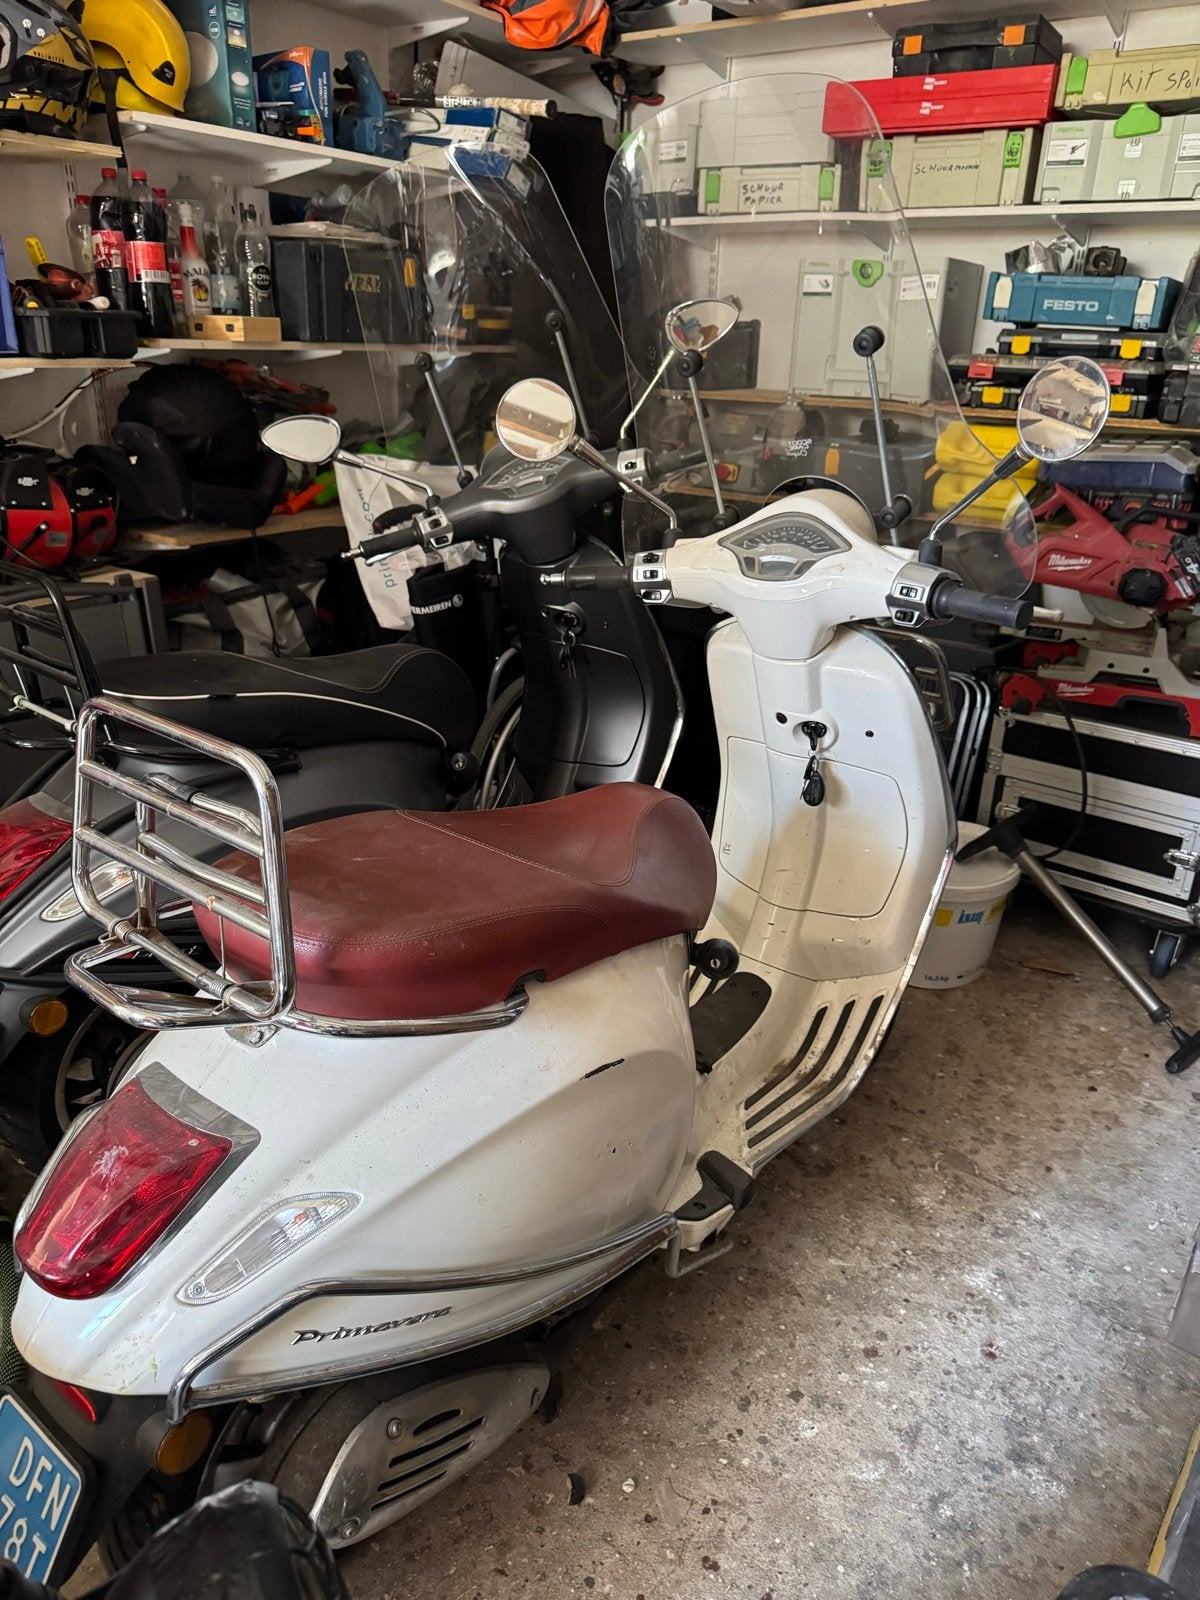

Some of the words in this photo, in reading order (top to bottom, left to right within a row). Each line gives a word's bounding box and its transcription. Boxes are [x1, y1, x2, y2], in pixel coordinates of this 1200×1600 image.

[1042, 299, 1099, 312] FESTO
[1048, 553, 1093, 567] Milwaukee
[1057, 682, 1095, 694] Milwaukee
[290, 1306, 452, 1346] Primavera
[9, 1436, 71, 1532] DFN
